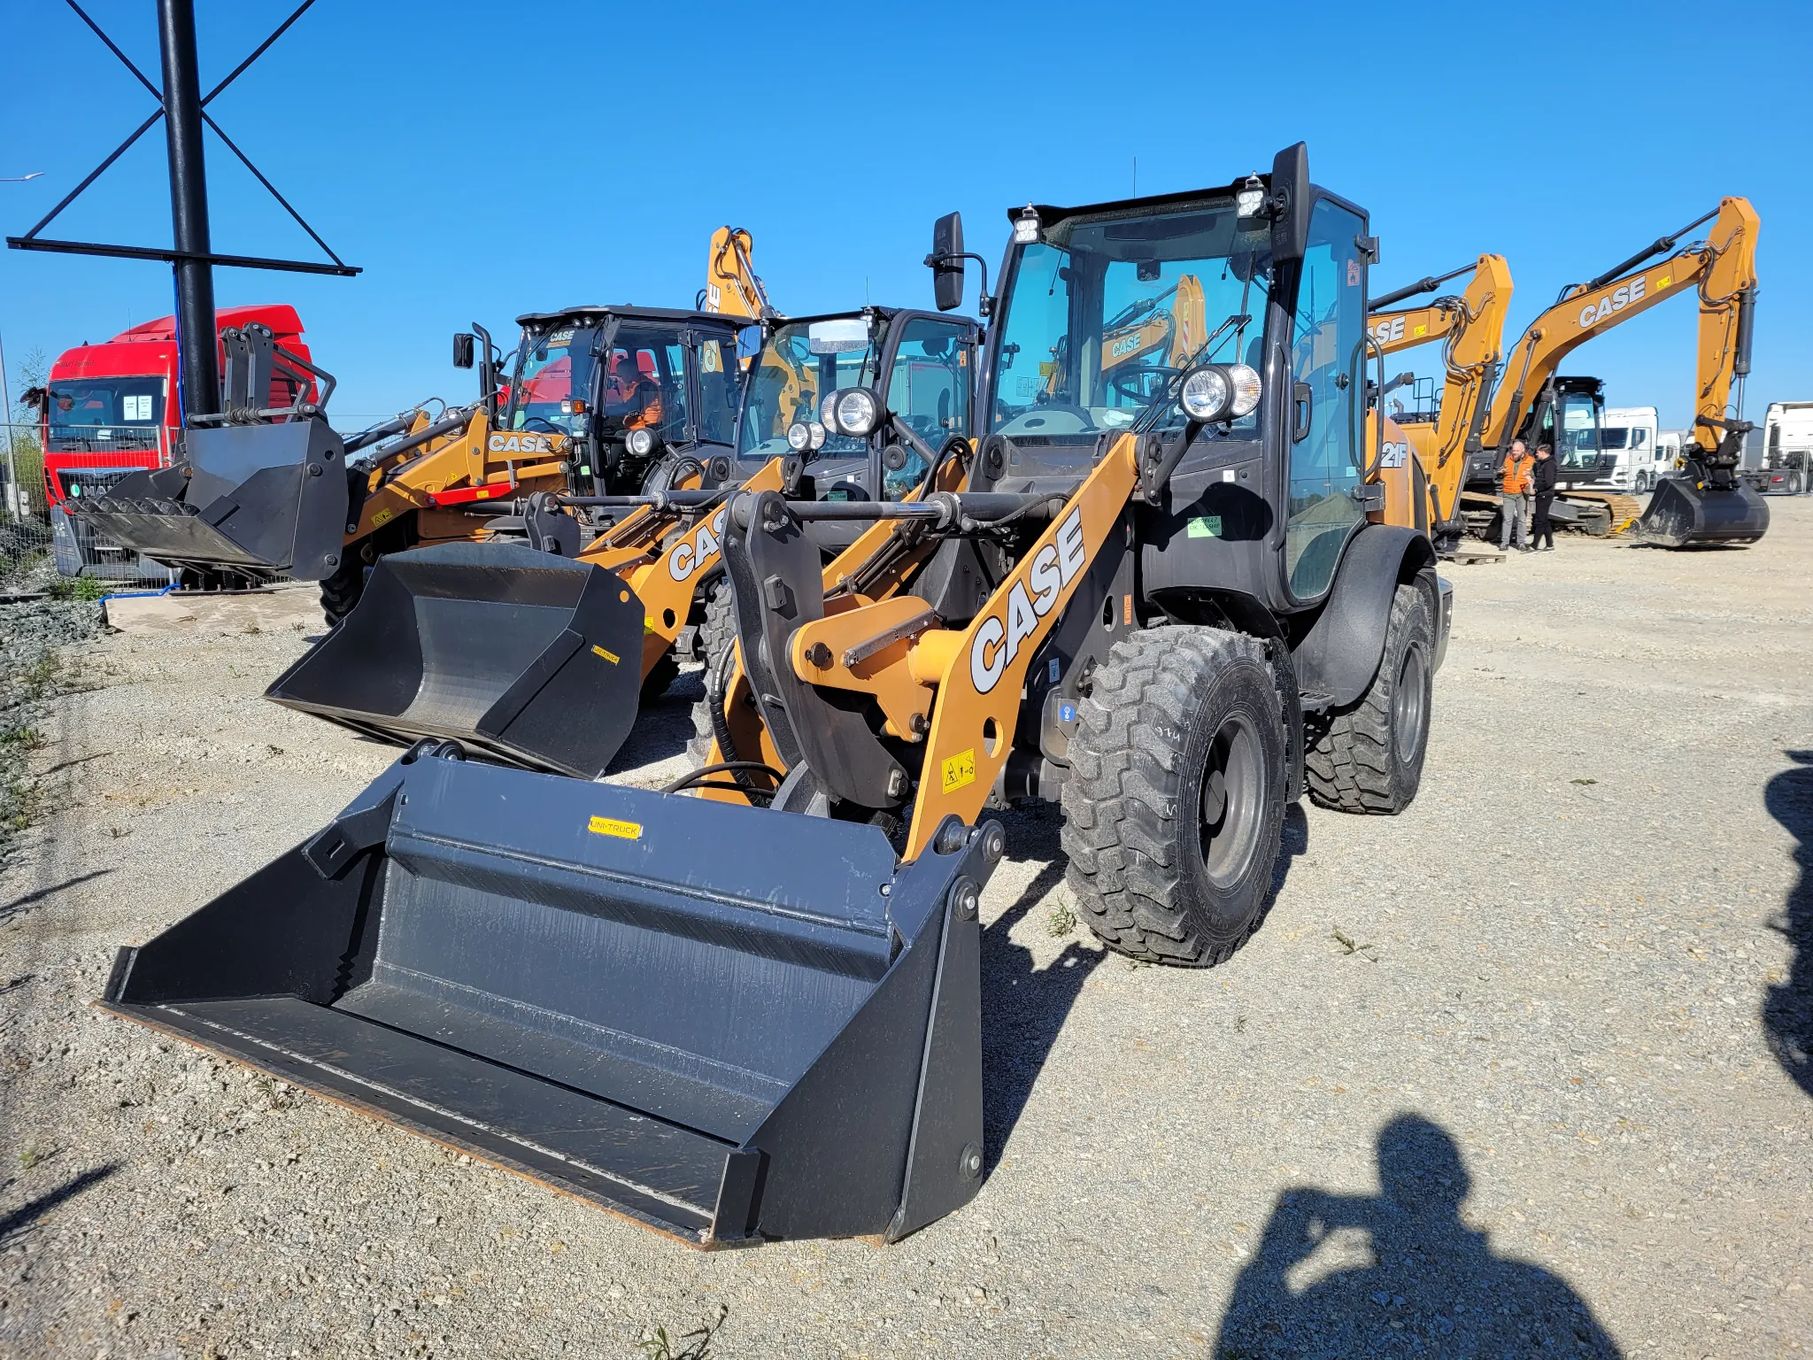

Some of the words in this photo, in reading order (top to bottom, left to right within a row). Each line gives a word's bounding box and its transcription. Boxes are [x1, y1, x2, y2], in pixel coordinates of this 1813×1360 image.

[1579, 274, 1647, 328] CASE
[550, 330, 575, 342] CASE
[1112, 333, 1141, 358] CASE
[488, 434, 551, 453] CASE
[83, 485, 114, 497] MA
[970, 504, 1086, 695] CASE
